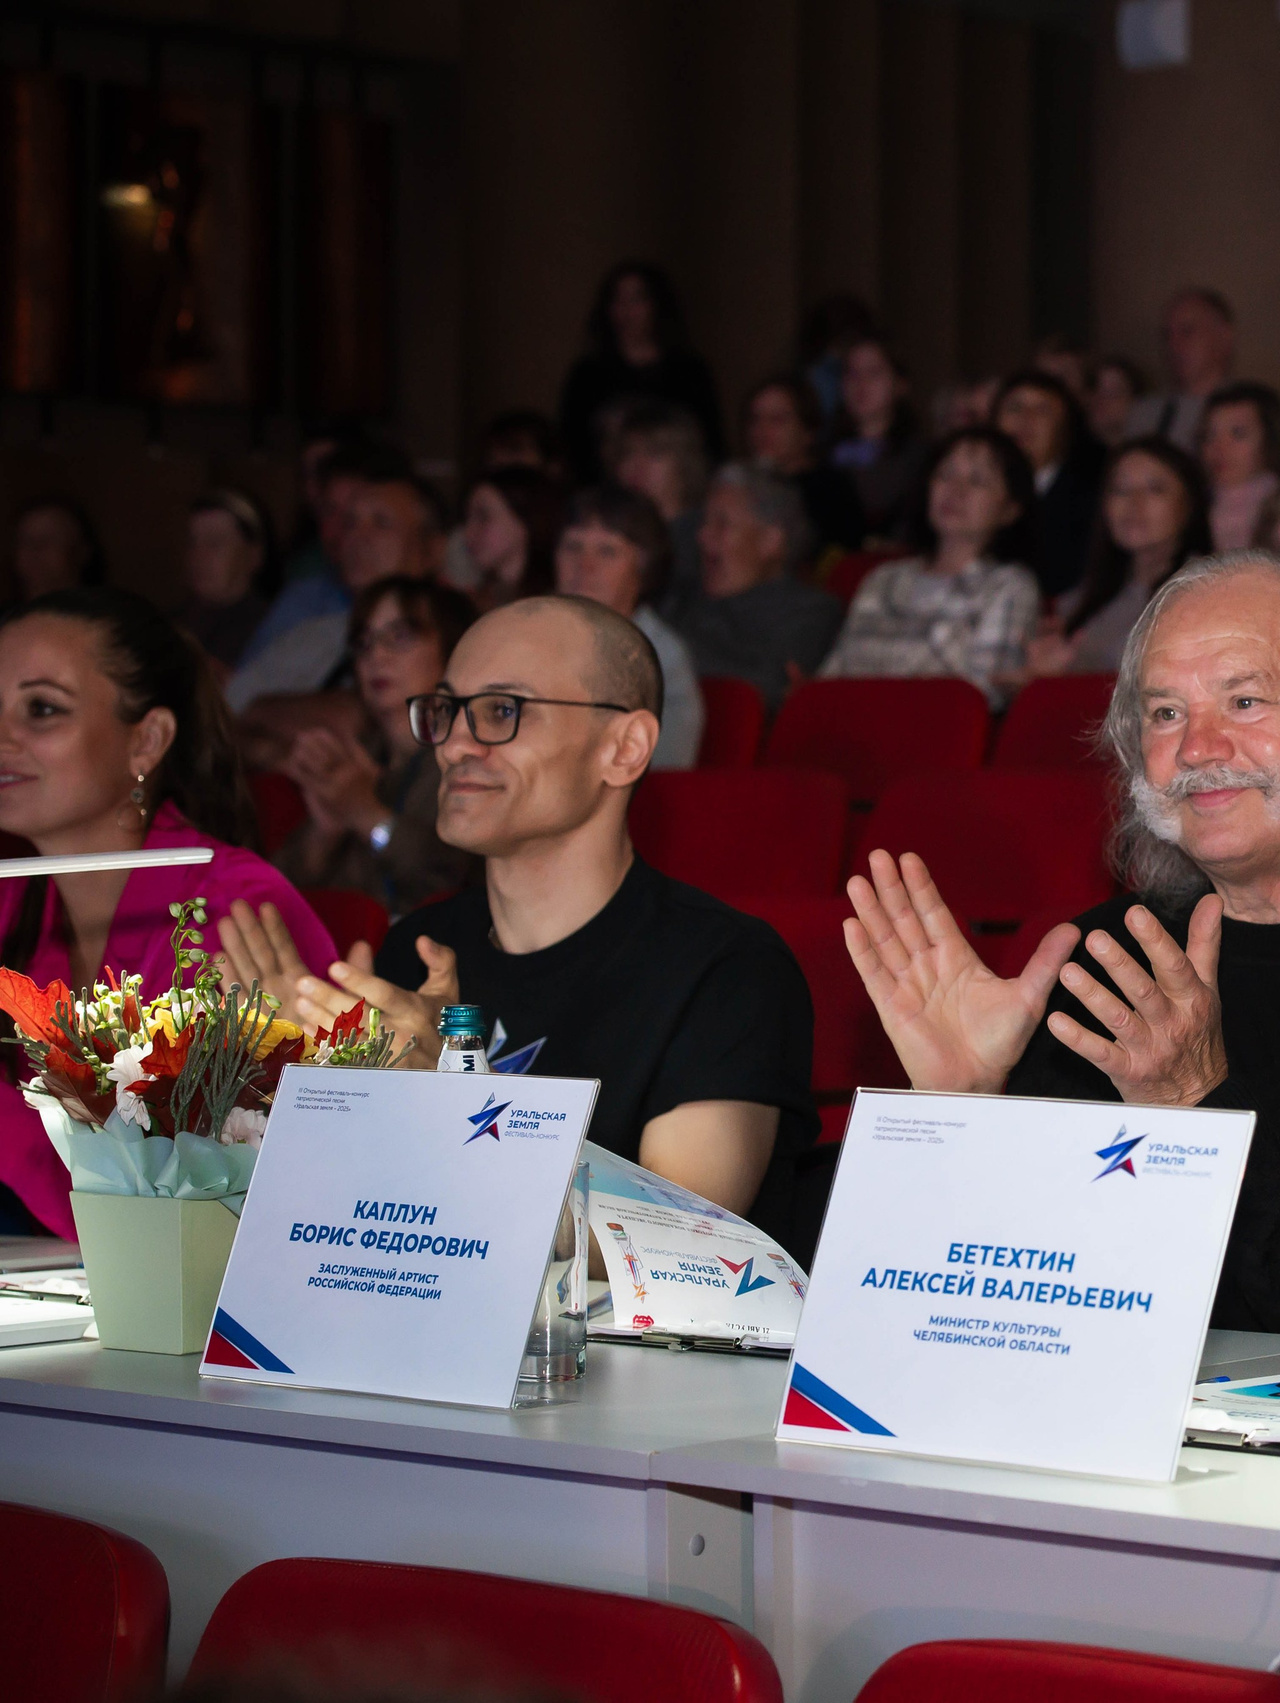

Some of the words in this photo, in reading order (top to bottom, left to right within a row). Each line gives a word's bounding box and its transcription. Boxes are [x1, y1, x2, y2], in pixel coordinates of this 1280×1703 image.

[303, 1087, 326, 1095] Открытый
[327, 1089, 370, 1098] фестиваль-конкурс
[507, 1119, 540, 1130] ЗЕМЛЯ
[510, 1109, 567, 1121] УРАЛЬСКАЯ
[504, 1131, 559, 1141] ФЕСТИВАЛЬ-КОНКУРС
[1145, 1155, 1185, 1165] ЗЕМЛЯ
[1148, 1143, 1218, 1156] УРАЛЬСКАЯ
[353, 1199, 438, 1226] КАПЛУН
[289, 1223, 356, 1247] БОРИС
[360, 1229, 490, 1260] ФЕДОРОВИЧ
[677, 1261, 724, 1276] ЗЕМЛЯ
[946, 1242, 1076, 1274] БЕТЕХТИН
[318, 1262, 397, 1281] ЗАСЛУЖЕННЫЙ
[398, 1270, 439, 1285] АРТИСТ
[649, 1269, 731, 1289] УРАЛЬСКАЯ
[307, 1276, 375, 1293] РОССИЙСКОЙ
[377, 1282, 442, 1301] ФЕДЕРАЦИИ
[860, 1266, 977, 1297] АЛЕКСЕЙ
[981, 1277, 1154, 1313] ВАЛЕРЬЕВИЧ
[928, 1314, 990, 1332] МИНИСТР
[992, 1320, 1062, 1338] КУЛЬТУРЫ
[912, 1329, 1006, 1350] ЧЕЛЯБИНСКОЙ
[1009, 1338, 1071, 1356] ОБЛАСТИ
